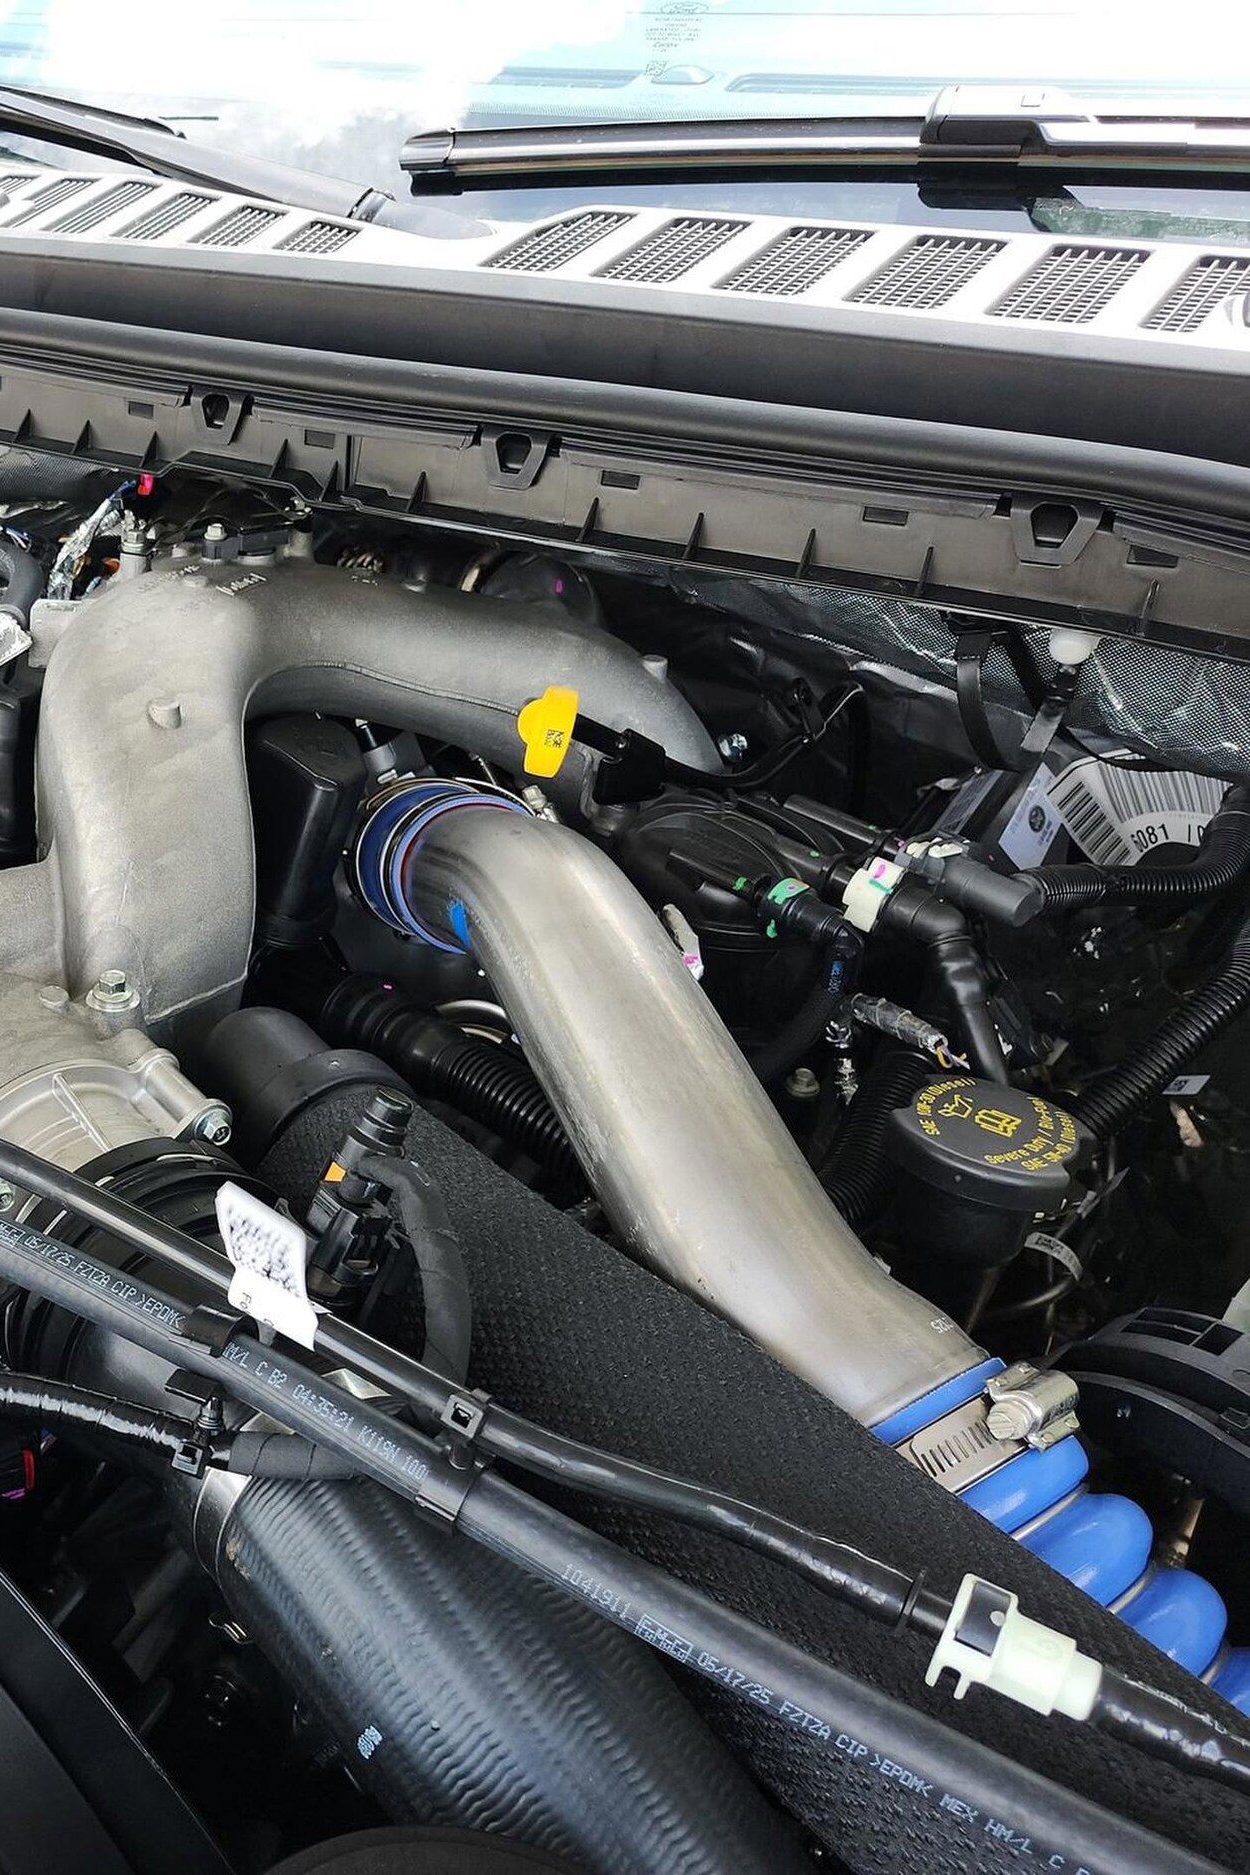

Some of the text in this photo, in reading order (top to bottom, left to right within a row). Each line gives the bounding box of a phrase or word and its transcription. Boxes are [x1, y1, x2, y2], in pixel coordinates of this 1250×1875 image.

[984, 1148, 1030, 1164] Severe
[1028, 1135, 1054, 1154] Duty
[1021, 1158, 1048, 1171] SAE
[24, 1236, 75, 1265] 05/17/25
[111, 1281, 136, 1299] CIP
[255, 1361, 268, 1376] C
[269, 1369, 287, 1389] B2
[292, 1384, 354, 1432] 04:35:21
[560, 1563, 631, 1619] 1041911
[697, 1651, 774, 1704] 05/17/25
[835, 1734, 868, 1758] CIP
[868, 1754, 933, 1798] >EPDM<
[939, 1793, 979, 1823] MEX
[984, 1818, 1033, 1854] HM/L
[1049, 1854, 1065, 1869] C
